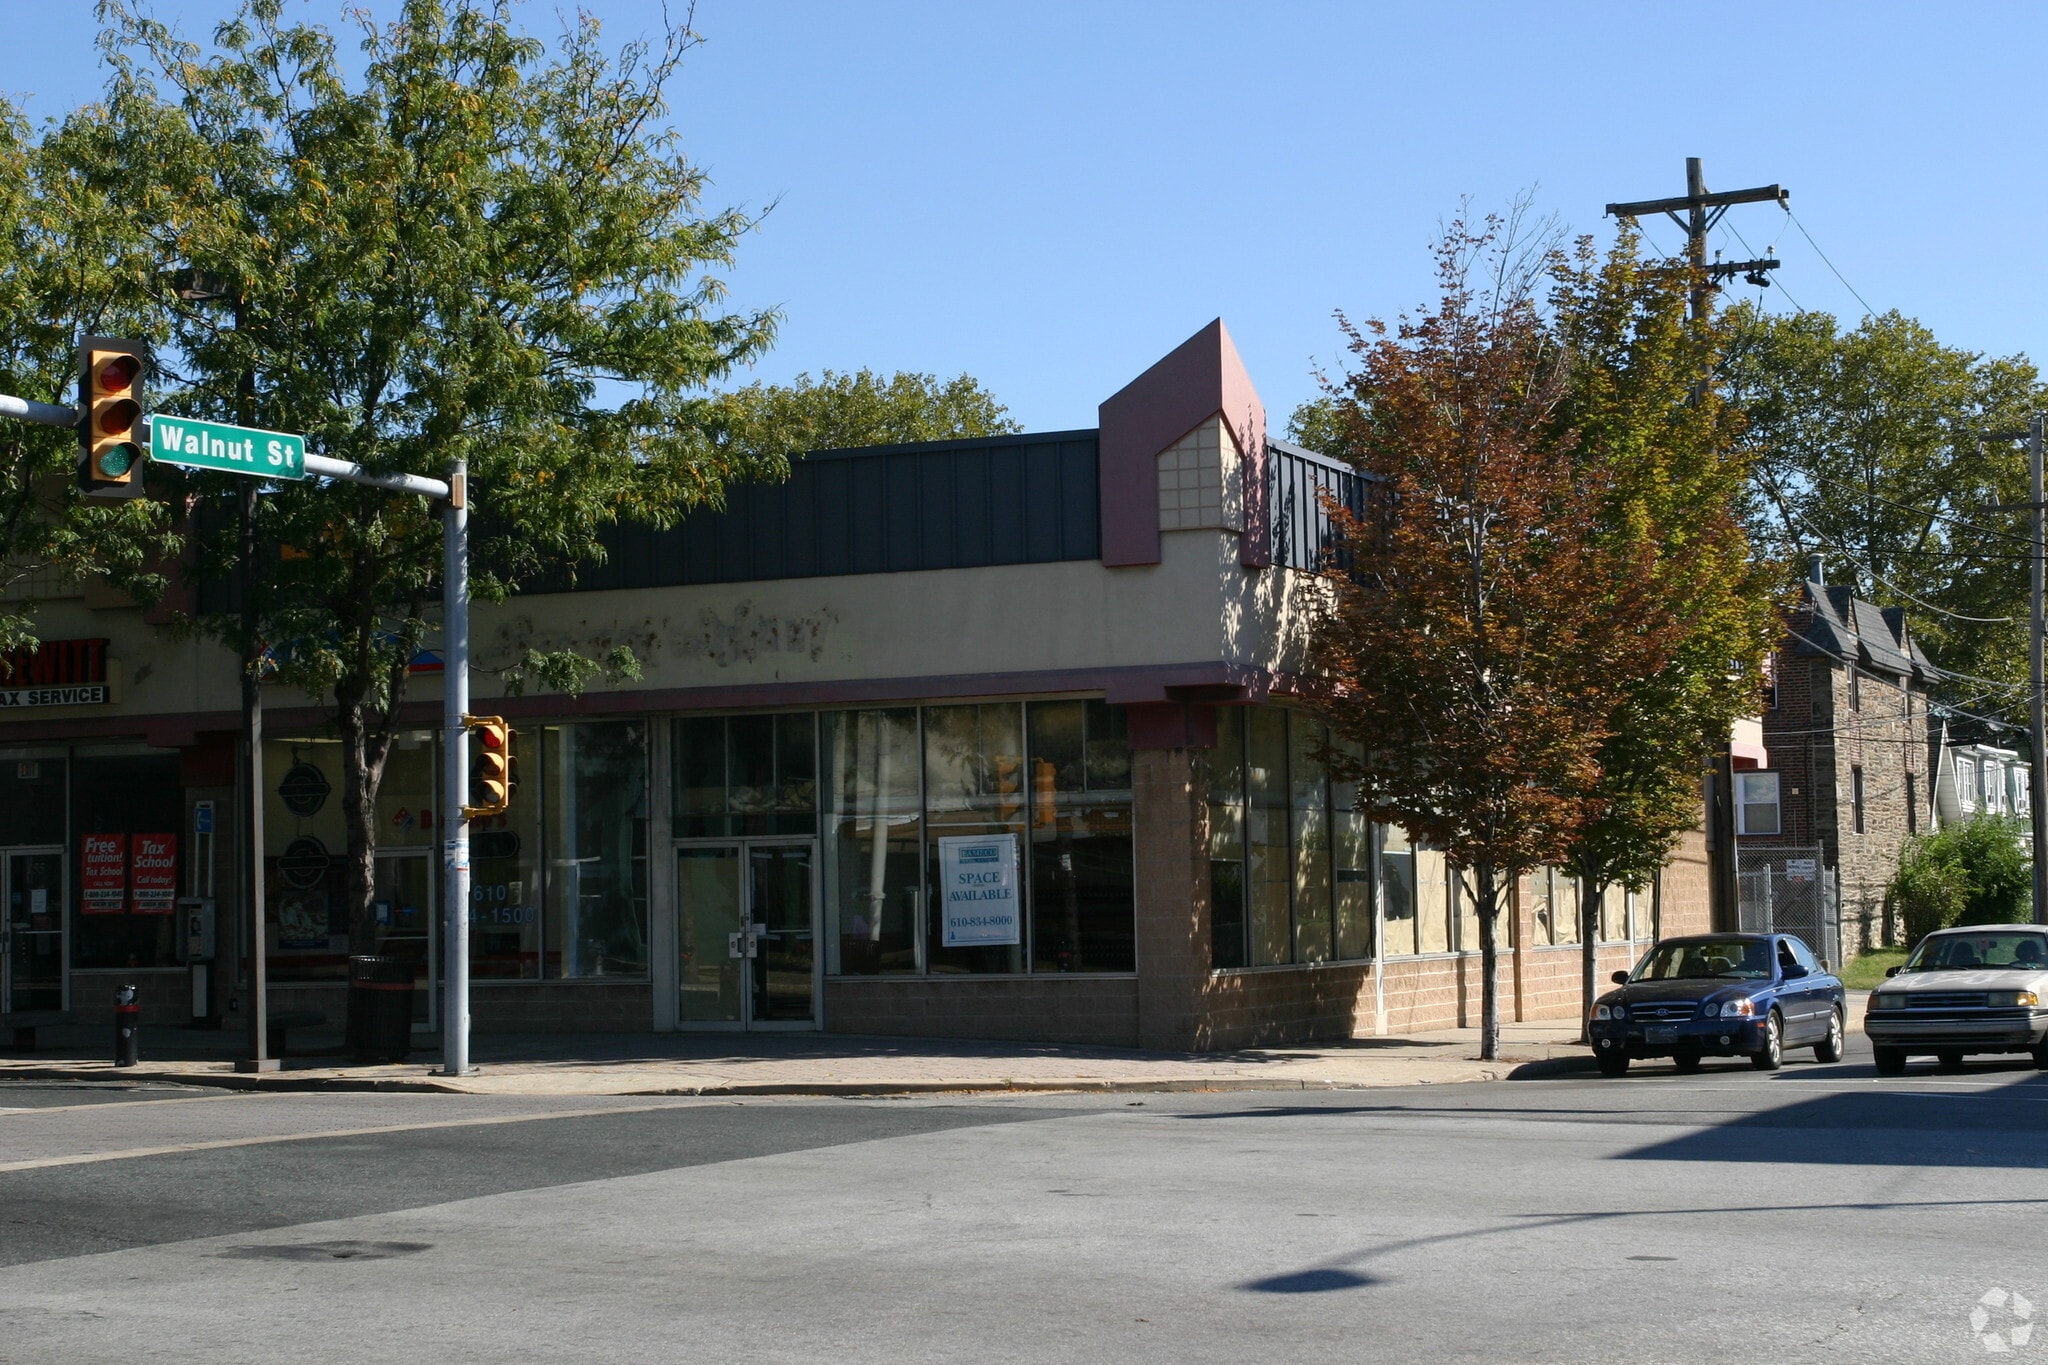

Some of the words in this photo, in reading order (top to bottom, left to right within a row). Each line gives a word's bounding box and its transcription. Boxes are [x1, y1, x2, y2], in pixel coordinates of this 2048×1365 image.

[160, 424, 253, 462] Walnut
[268, 440, 294, 468] St
[28, 688, 101, 705] SERVICE
[85, 837, 116, 853] Free
[142, 840, 166, 855] Tax
[87, 851, 123, 863] tuition!
[134, 855, 174, 868] School
[86, 867, 98, 876] Tax
[99, 866, 123, 876] School
[136, 875, 150, 884] Call
[958, 872, 1001, 884] SPACE
[473, 884, 506, 902] 610
[949, 888, 1012, 902] AVAILABLE
[950, 916, 1013, 927] 610-834-8000
